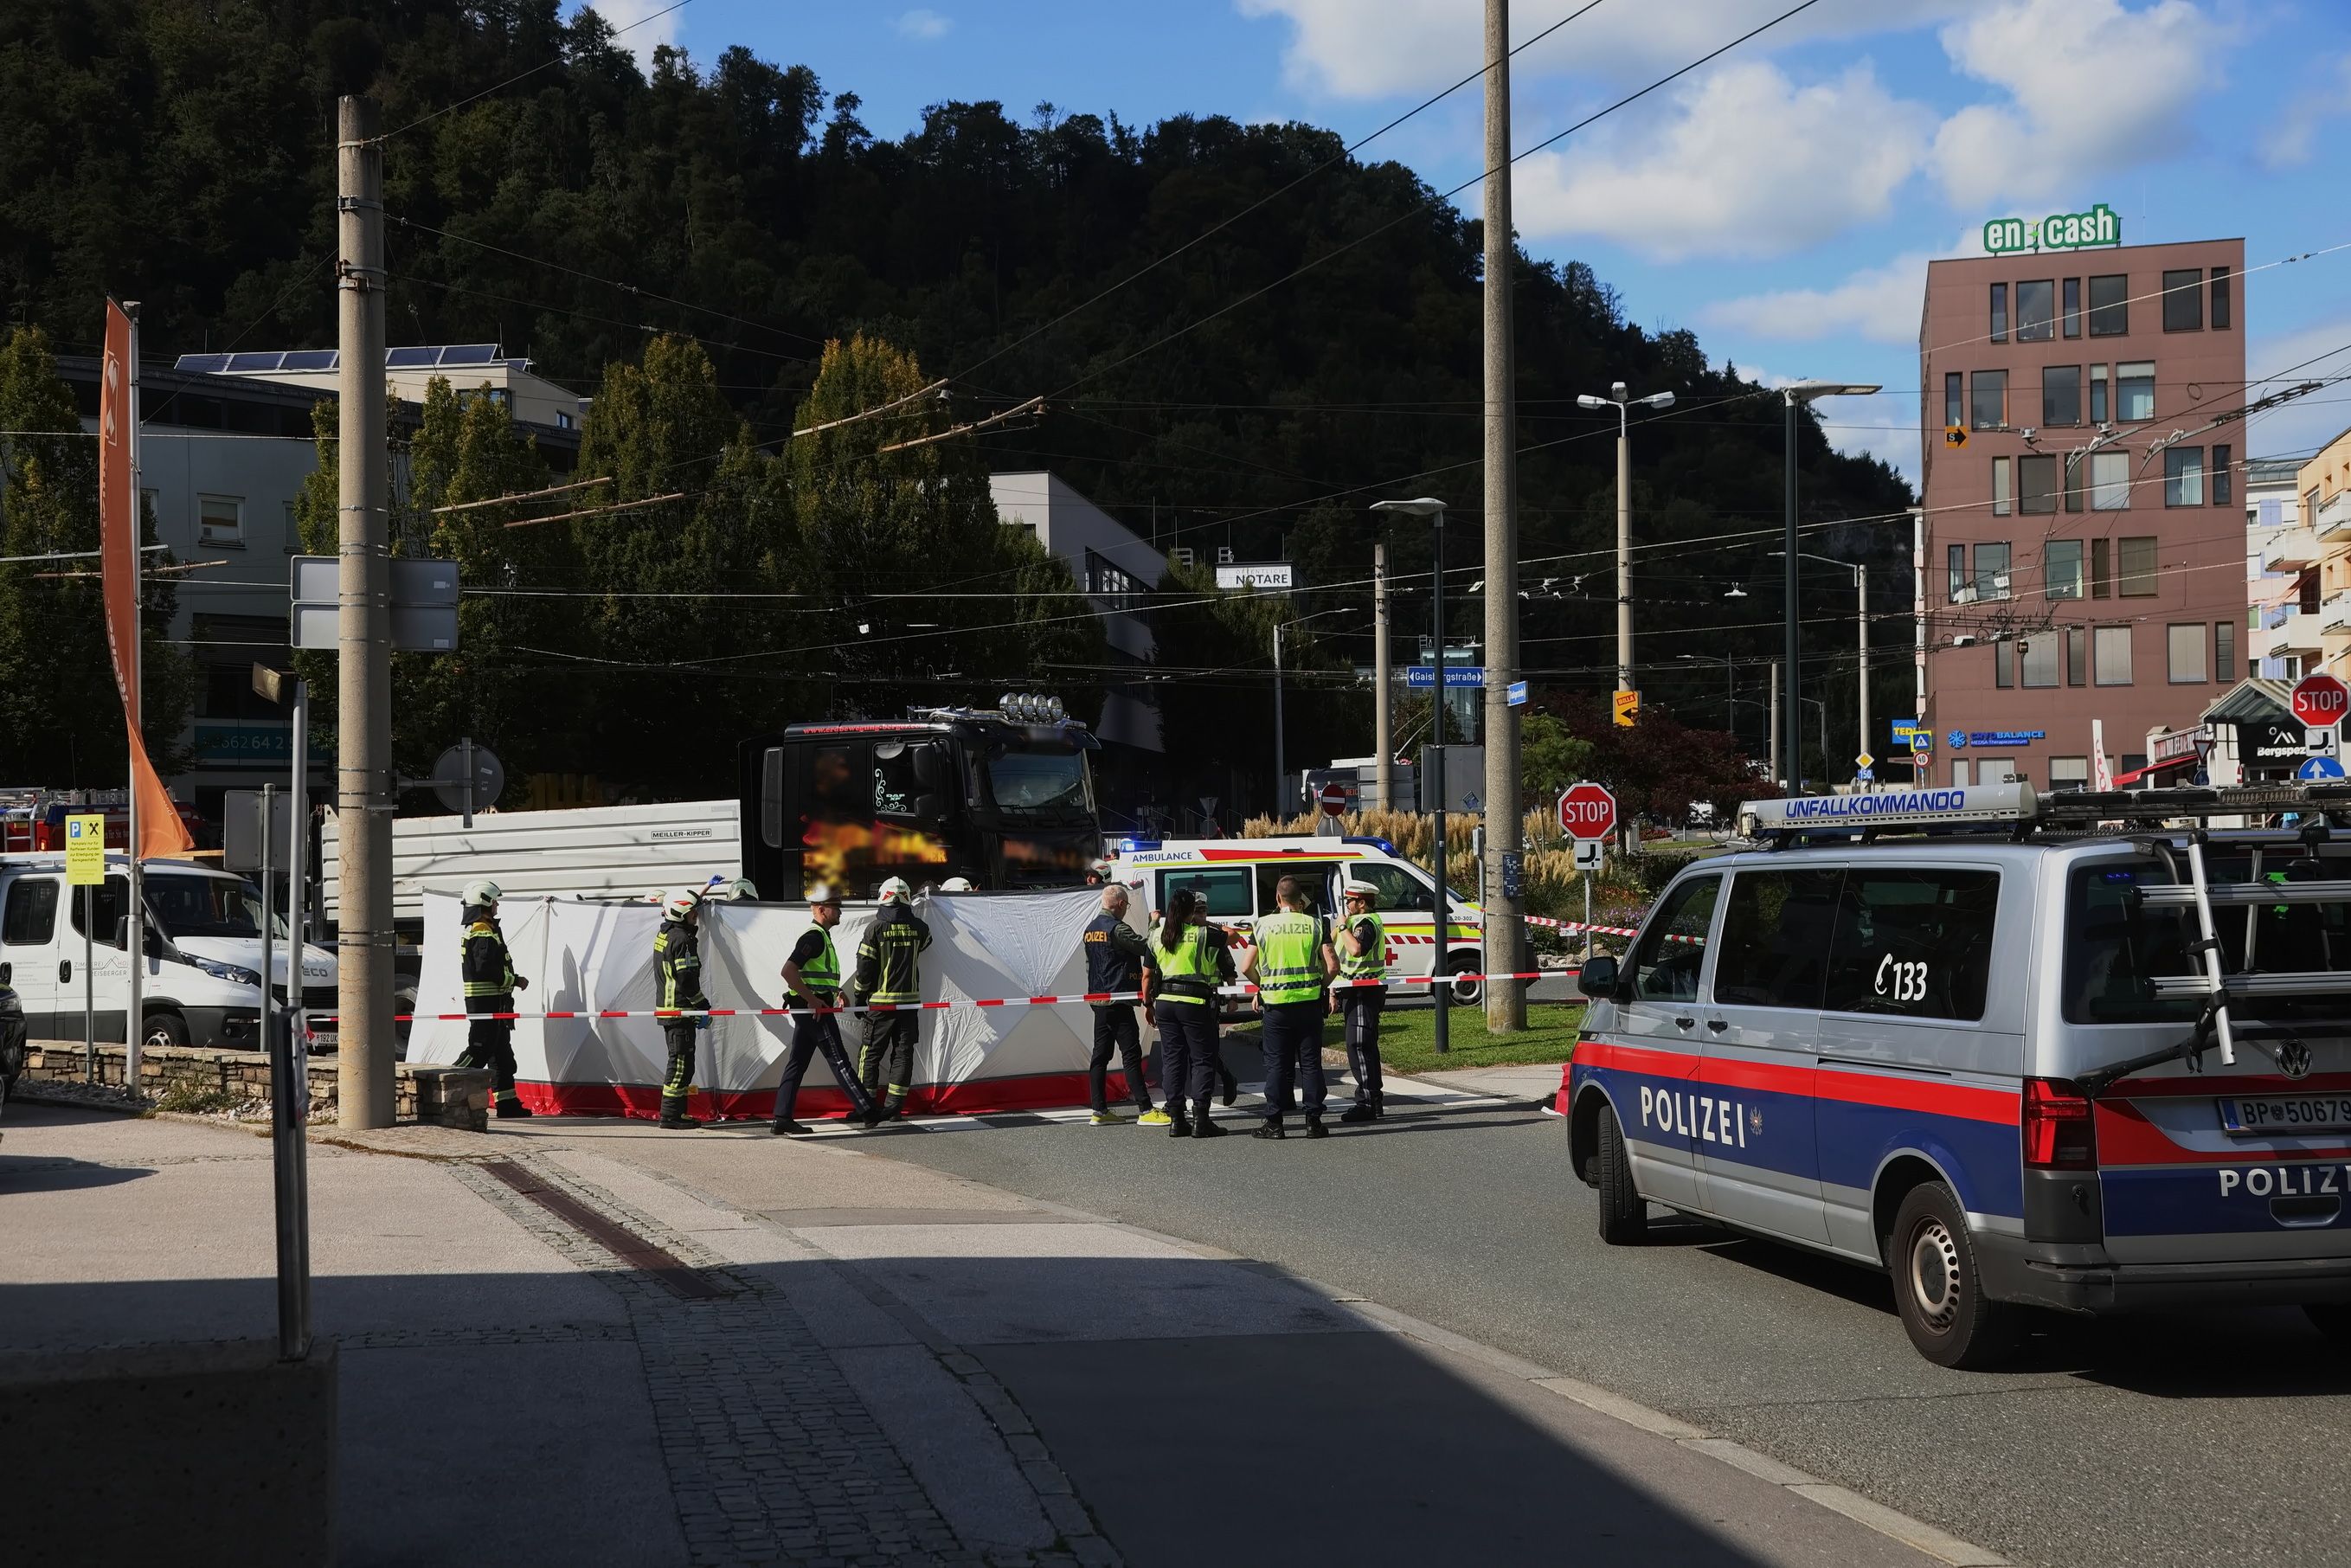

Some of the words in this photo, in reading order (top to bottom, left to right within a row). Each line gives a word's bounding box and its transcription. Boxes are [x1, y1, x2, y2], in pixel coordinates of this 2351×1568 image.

[2046, 206, 2115, 247] cash
[1236, 575, 1288, 585] NOTARE
[1616, 695, 1635, 706] BILLA
[2296, 691, 2343, 712] STOP
[1860, 769, 1872, 779] 150
[1566, 801, 1609, 823] STOP
[1786, 790, 1965, 819] UNFALLKOMMANDO
[1133, 852, 1192, 862] AMBULANCE
[1892, 961, 1928, 1001] 133
[1641, 1086, 1746, 1148] POLIZEI
[2242, 1102, 2269, 1124] BP
